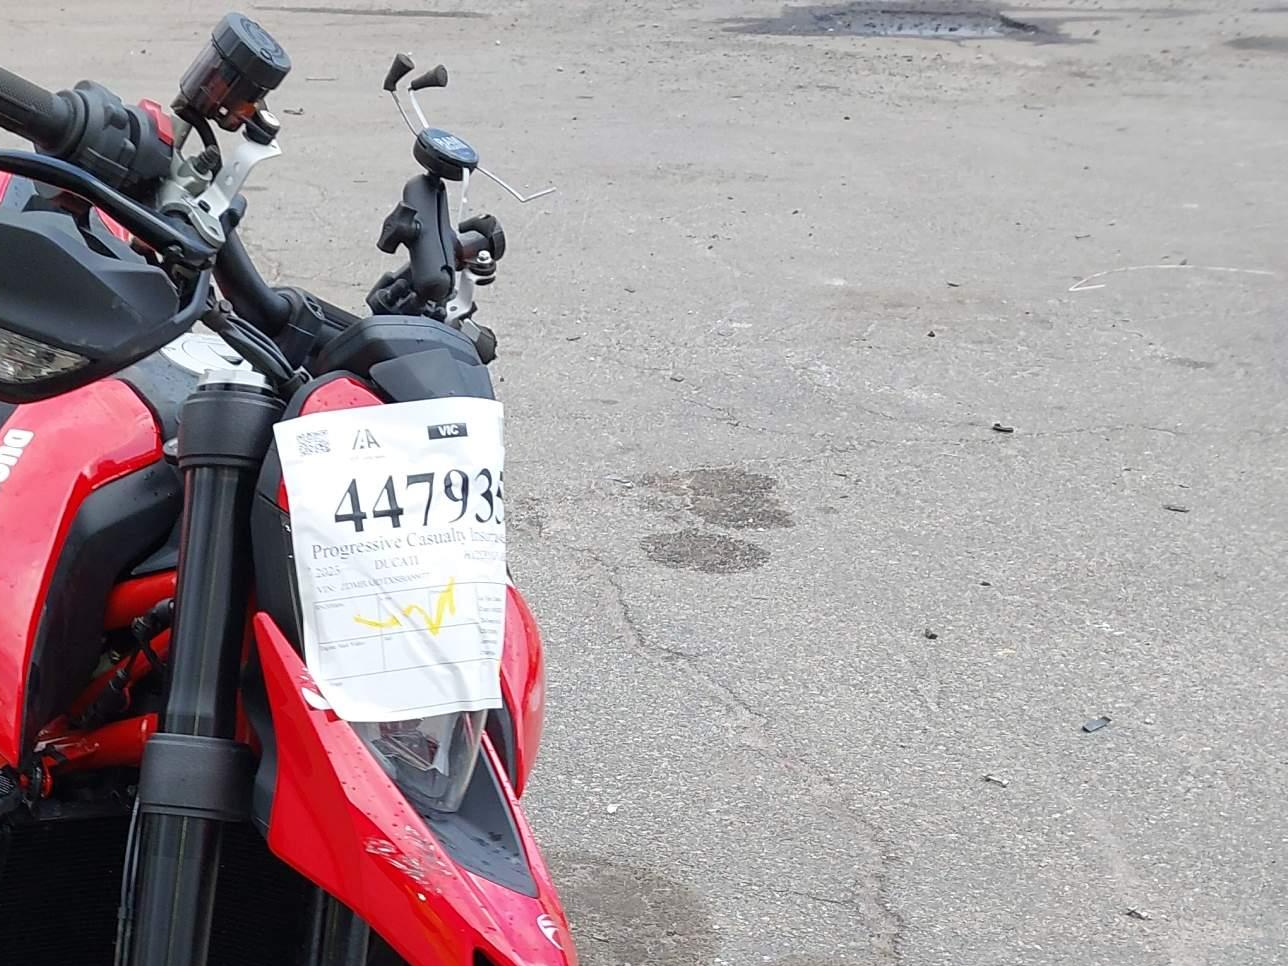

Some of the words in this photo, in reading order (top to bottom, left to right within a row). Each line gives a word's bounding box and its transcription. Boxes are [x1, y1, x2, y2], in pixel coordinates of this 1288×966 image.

[438, 424, 460, 436] VIC
[311, 536, 402, 560] Progressive
[407, 527, 467, 547] Casualty
[375, 555, 420, 571] DUCATI
